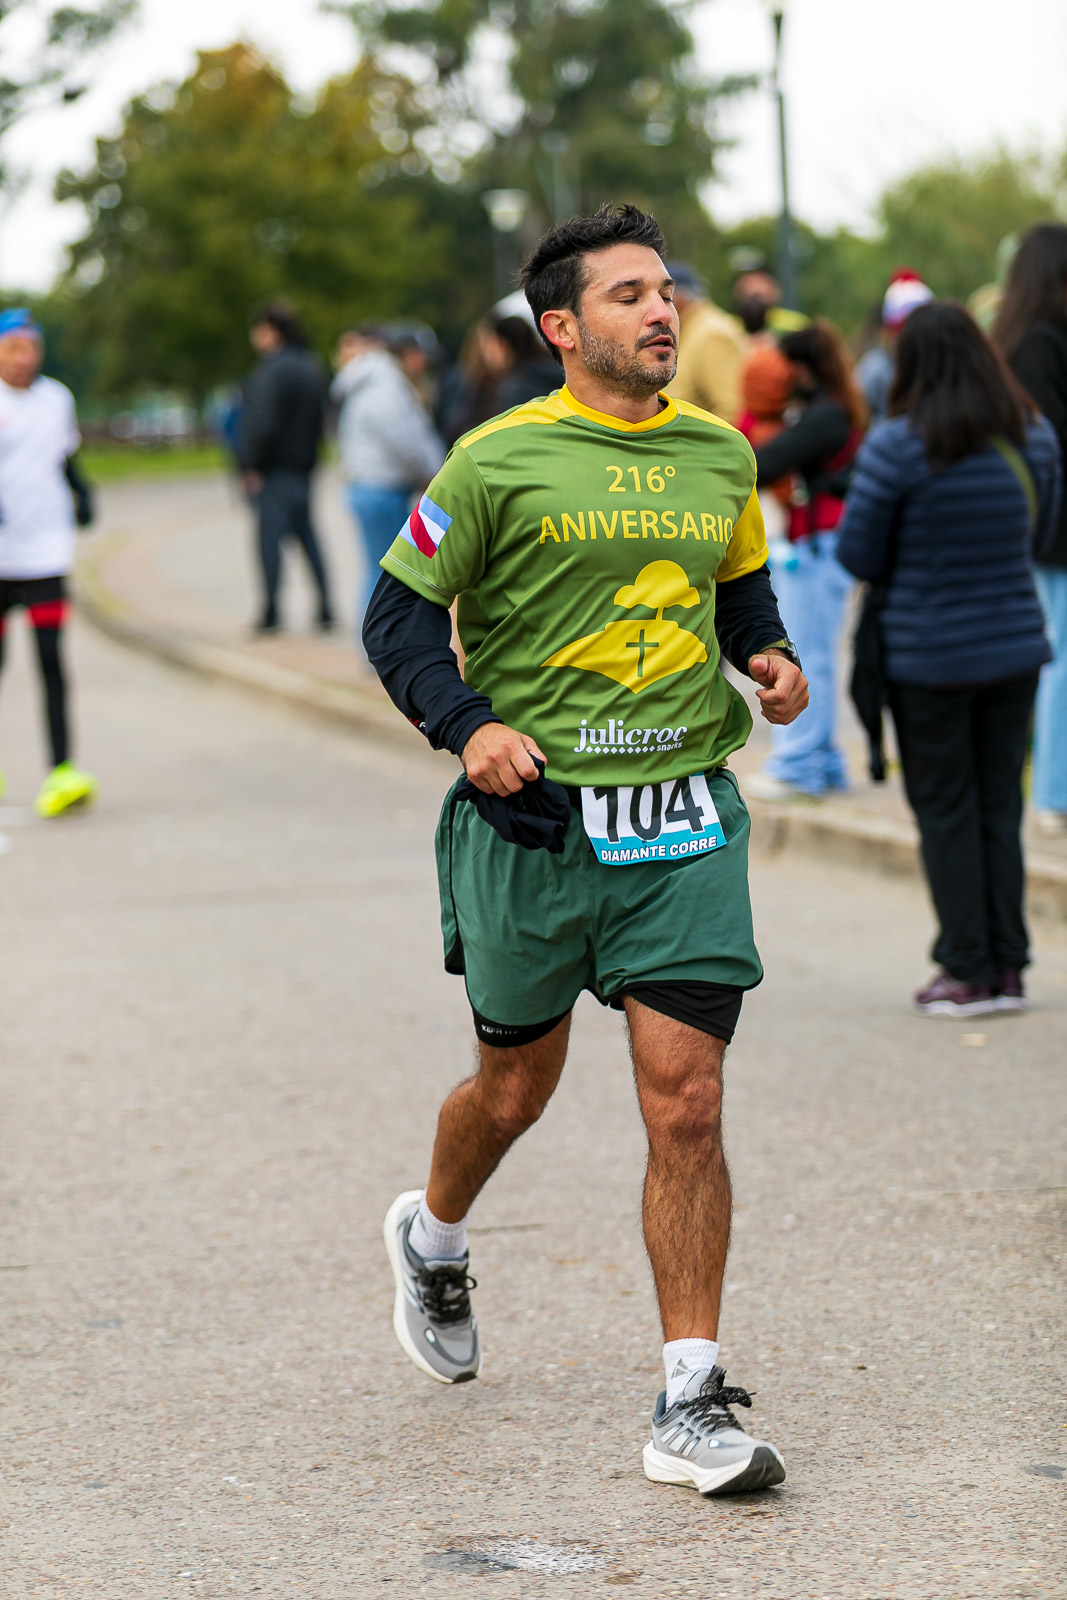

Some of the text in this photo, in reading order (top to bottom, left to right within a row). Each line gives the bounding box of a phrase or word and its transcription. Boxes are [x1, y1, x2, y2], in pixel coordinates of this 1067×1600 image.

[539, 510, 734, 545] ANIVERSARIO
[573, 718, 688, 753] julicroc
[592, 776, 705, 843] 104
[601, 836, 717, 862] DIAMANTE CORRE
